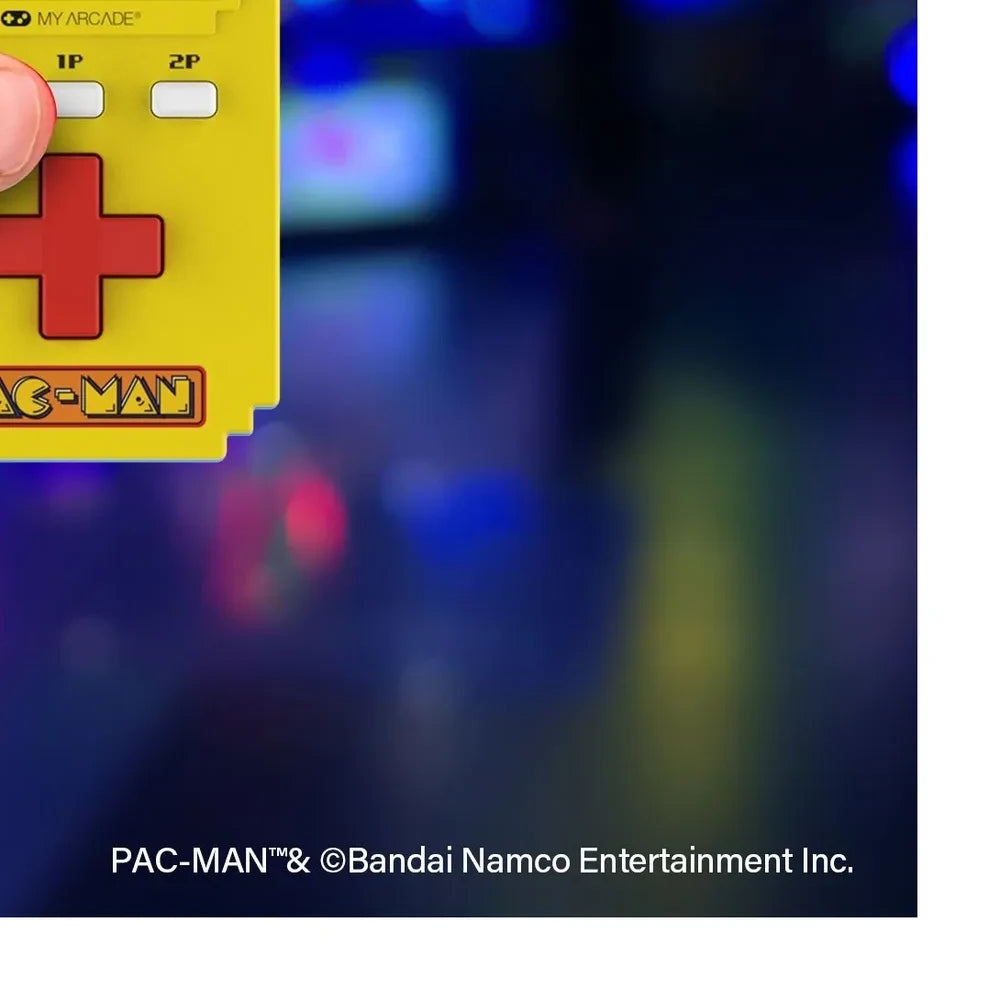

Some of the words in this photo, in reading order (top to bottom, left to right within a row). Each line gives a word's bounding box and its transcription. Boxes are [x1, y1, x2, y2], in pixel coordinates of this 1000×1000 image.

[37, 11, 63, 26] MY
[56, 54, 84, 69] 1P
[169, 54, 201, 70] 2P
